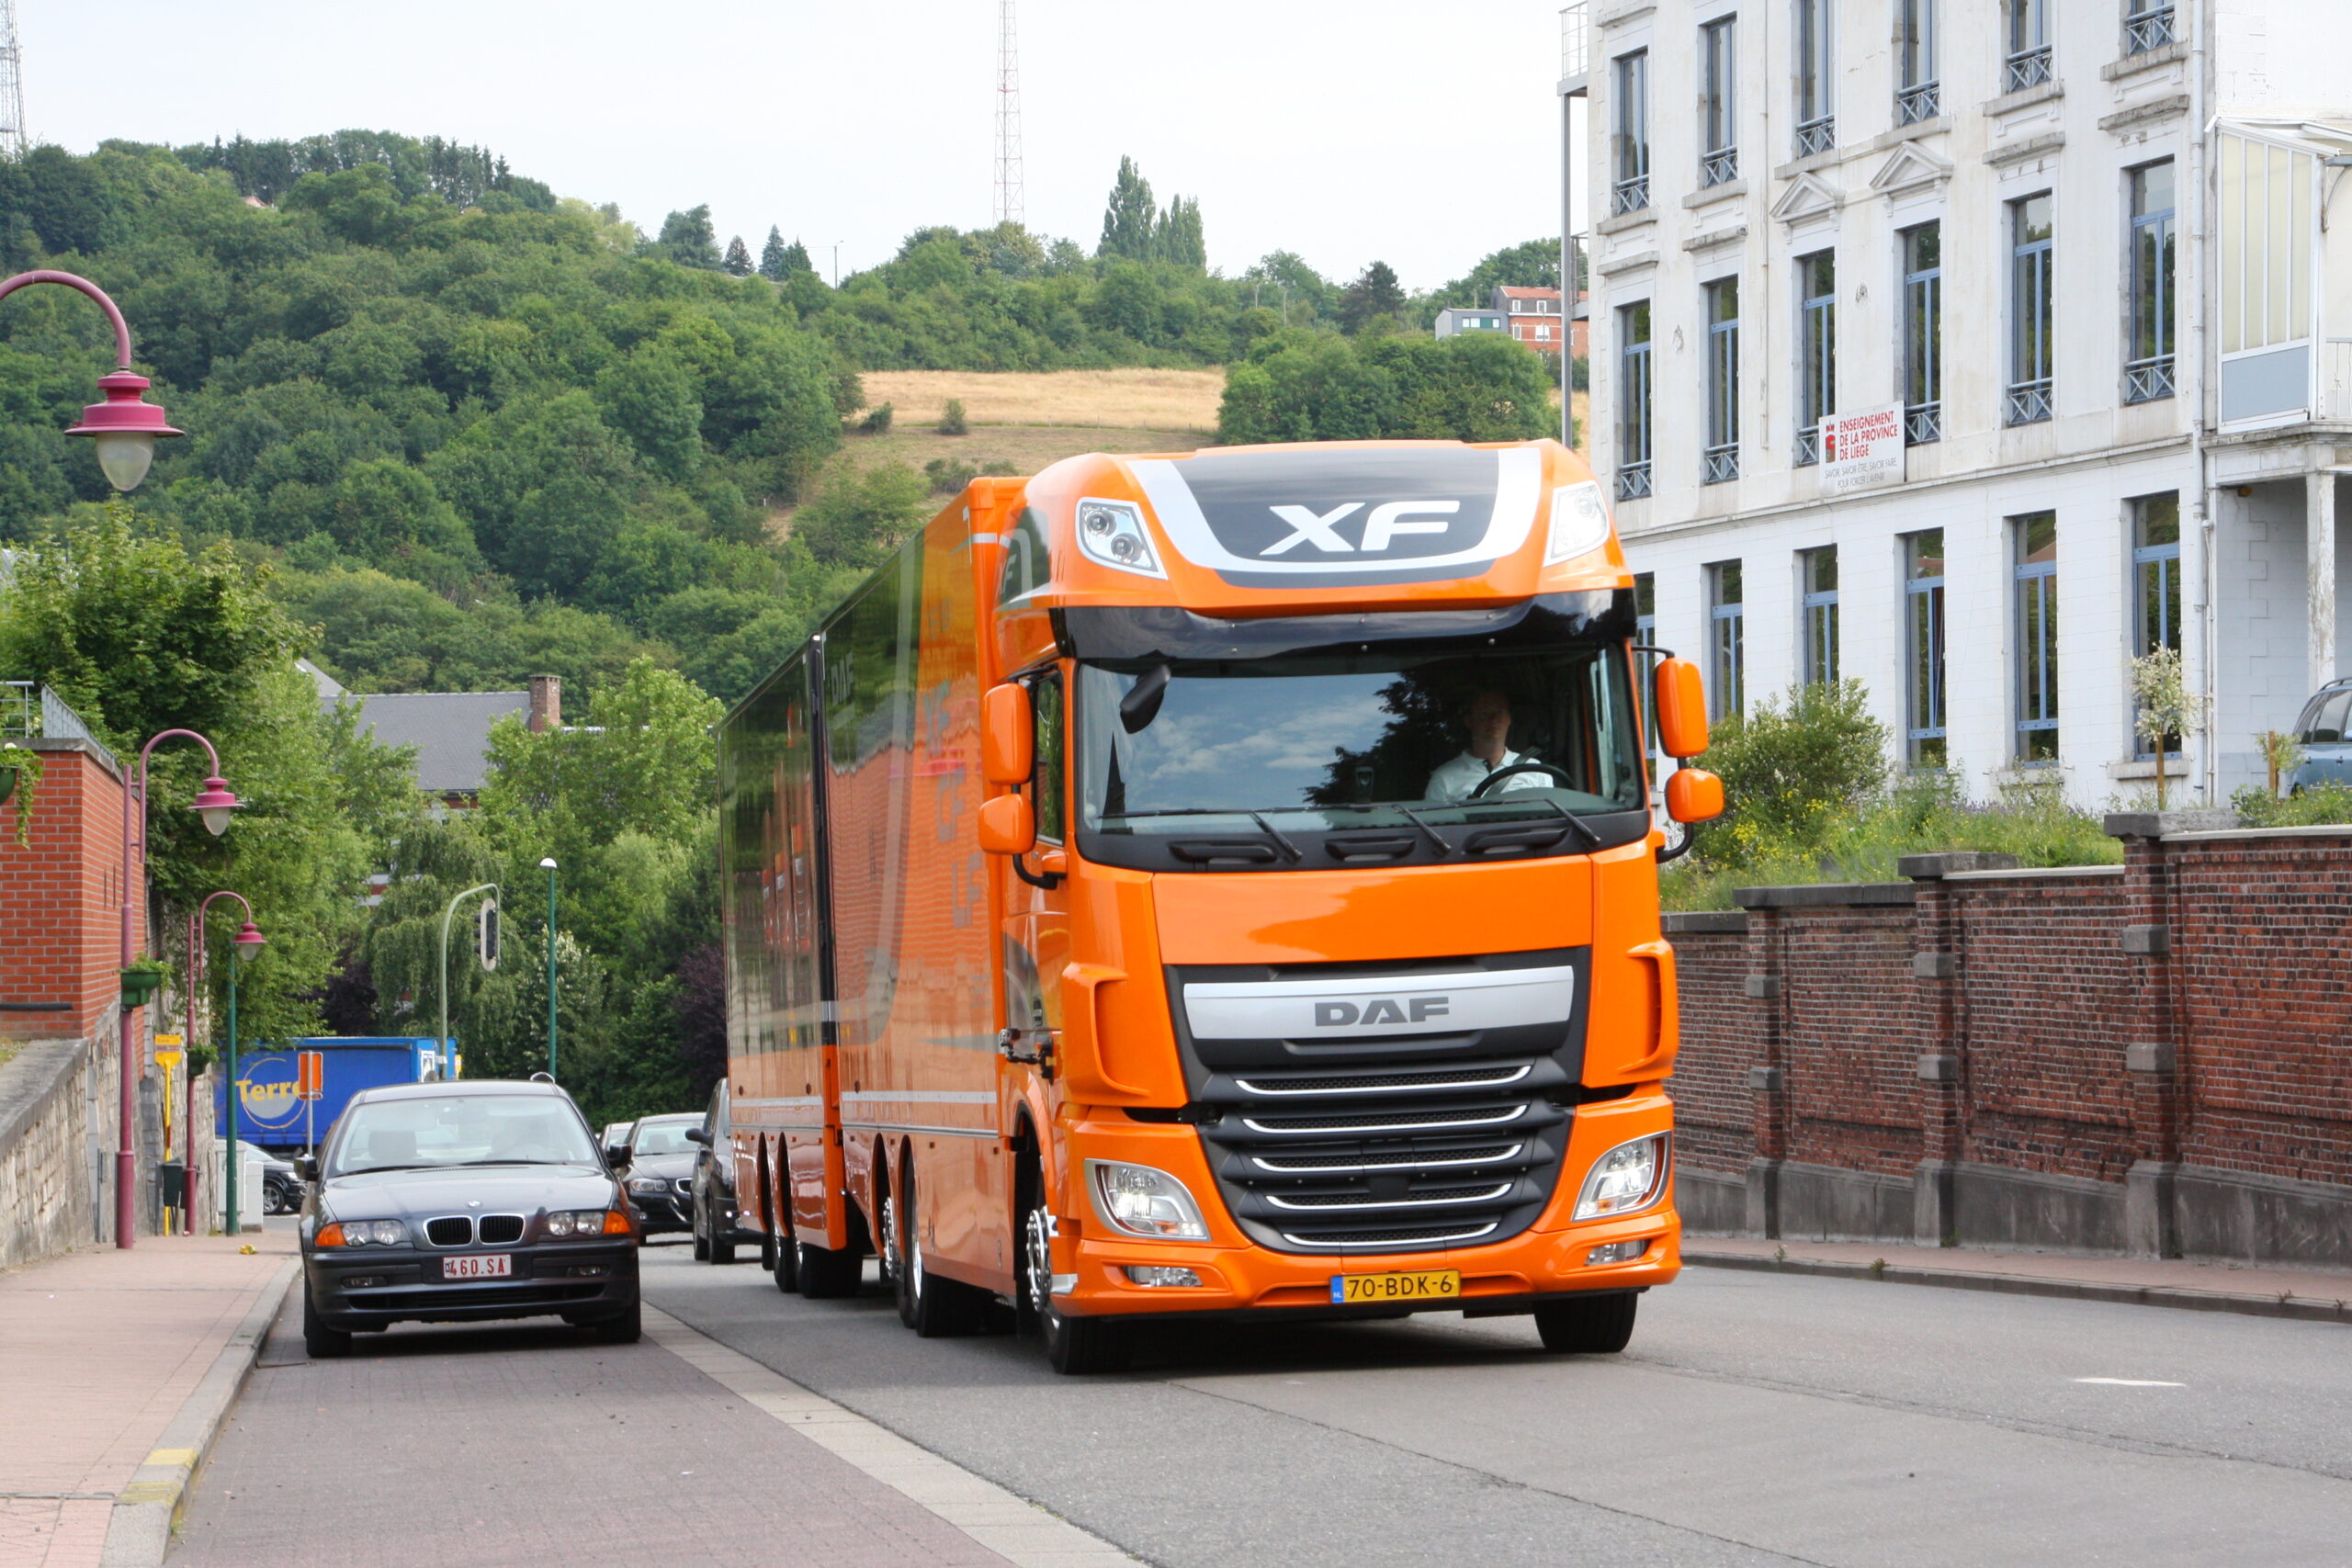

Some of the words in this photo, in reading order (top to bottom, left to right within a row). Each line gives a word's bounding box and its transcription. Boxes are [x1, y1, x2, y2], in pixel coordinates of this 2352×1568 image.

[1839, 411, 1894, 433] ENSEIGNEMENT
[1839, 434, 1849, 446] DE
[1850, 432, 1860, 445] LA
[1861, 424, 1898, 442] PROVINCE
[1839, 448, 1849, 461] DE
[1850, 444, 1870, 458] LIEGE
[1260, 501, 1460, 555] XF
[1315, 997, 1449, 1027] DAF
[1348, 1275, 1453, 1298] 70-BDK-6
